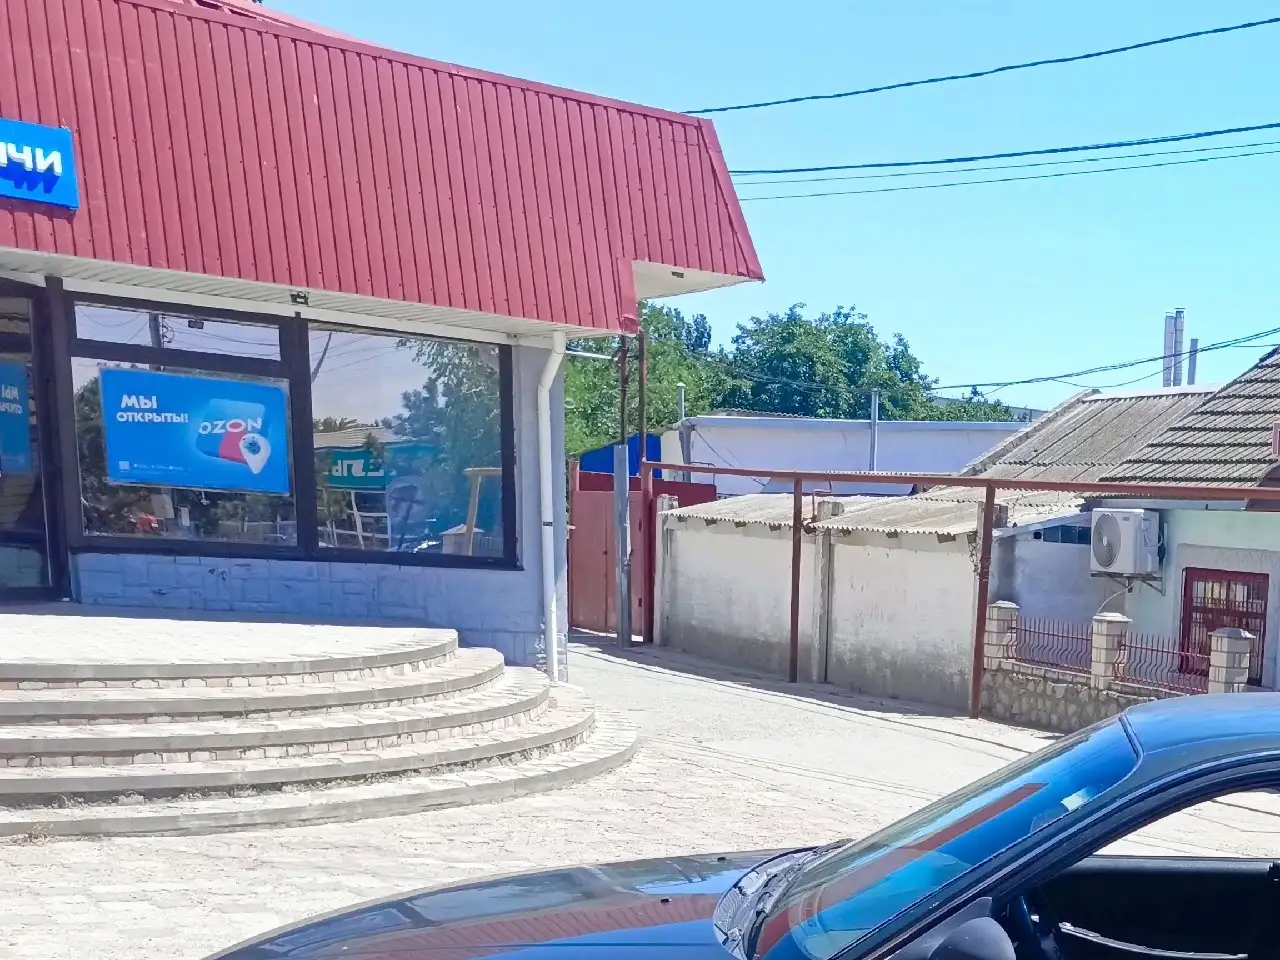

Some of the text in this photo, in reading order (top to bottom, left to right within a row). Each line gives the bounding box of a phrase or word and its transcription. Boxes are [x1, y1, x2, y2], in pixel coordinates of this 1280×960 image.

[121, 394, 158, 409] МЫ
[116, 411, 189, 424] ОТКРЫТЫ!
[199, 417, 263, 435] OZON
